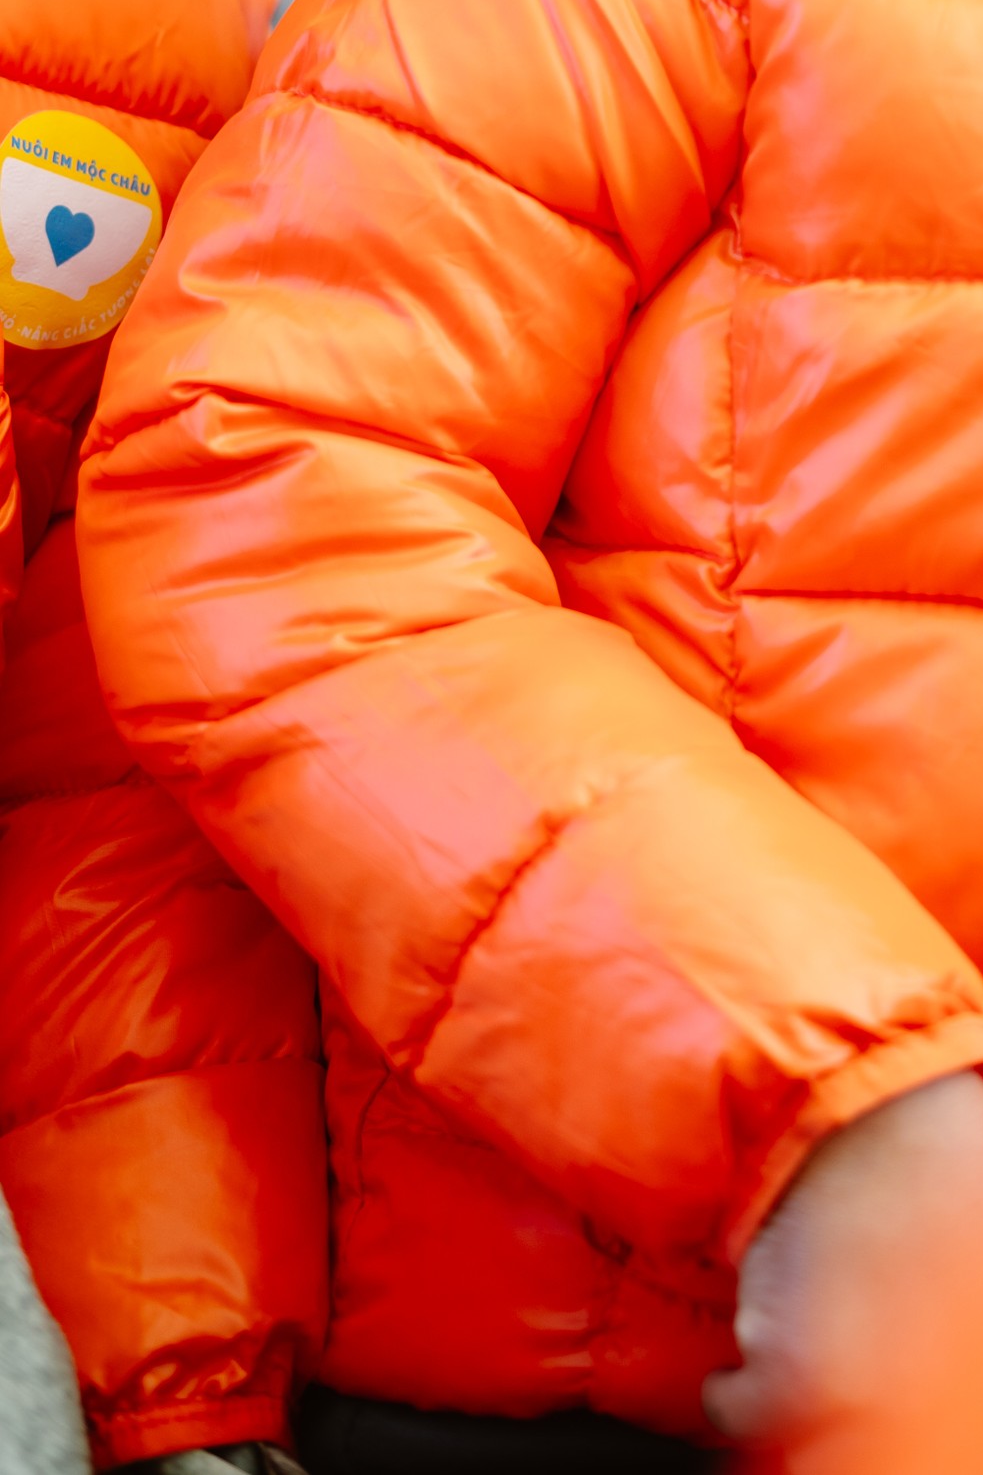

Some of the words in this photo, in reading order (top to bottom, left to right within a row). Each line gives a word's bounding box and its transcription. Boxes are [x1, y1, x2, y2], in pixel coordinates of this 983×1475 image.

[11, 136, 48, 160] NUÔI
[52, 151, 72, 168] EM
[76, 160, 106, 181] MỘC
[111, 173, 151, 196] CHÂU
